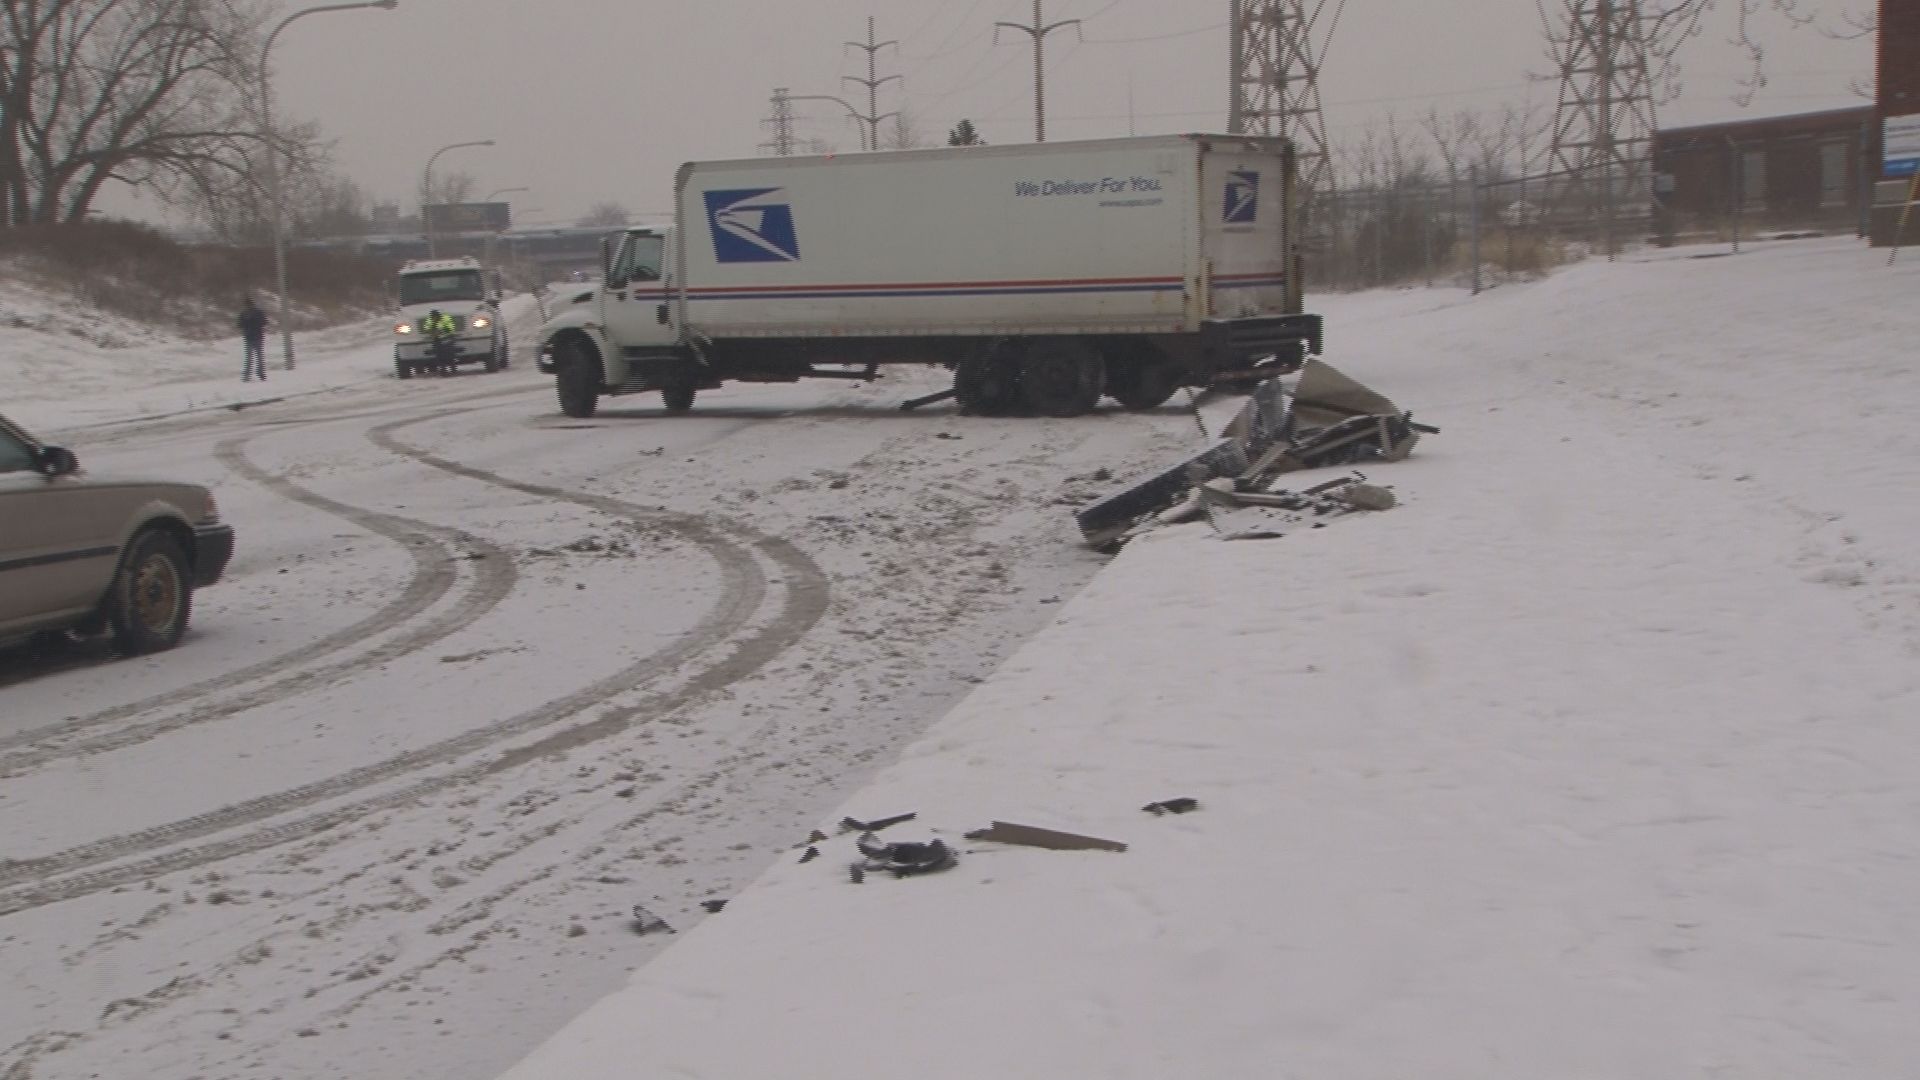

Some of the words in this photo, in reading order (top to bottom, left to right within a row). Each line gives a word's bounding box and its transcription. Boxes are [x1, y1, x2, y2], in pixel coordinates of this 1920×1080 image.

[1015, 181, 1040, 197] We
[1041, 179, 1099, 196] Deliver
[1100, 177, 1128, 193] For
[1129, 175, 1163, 192] You.
